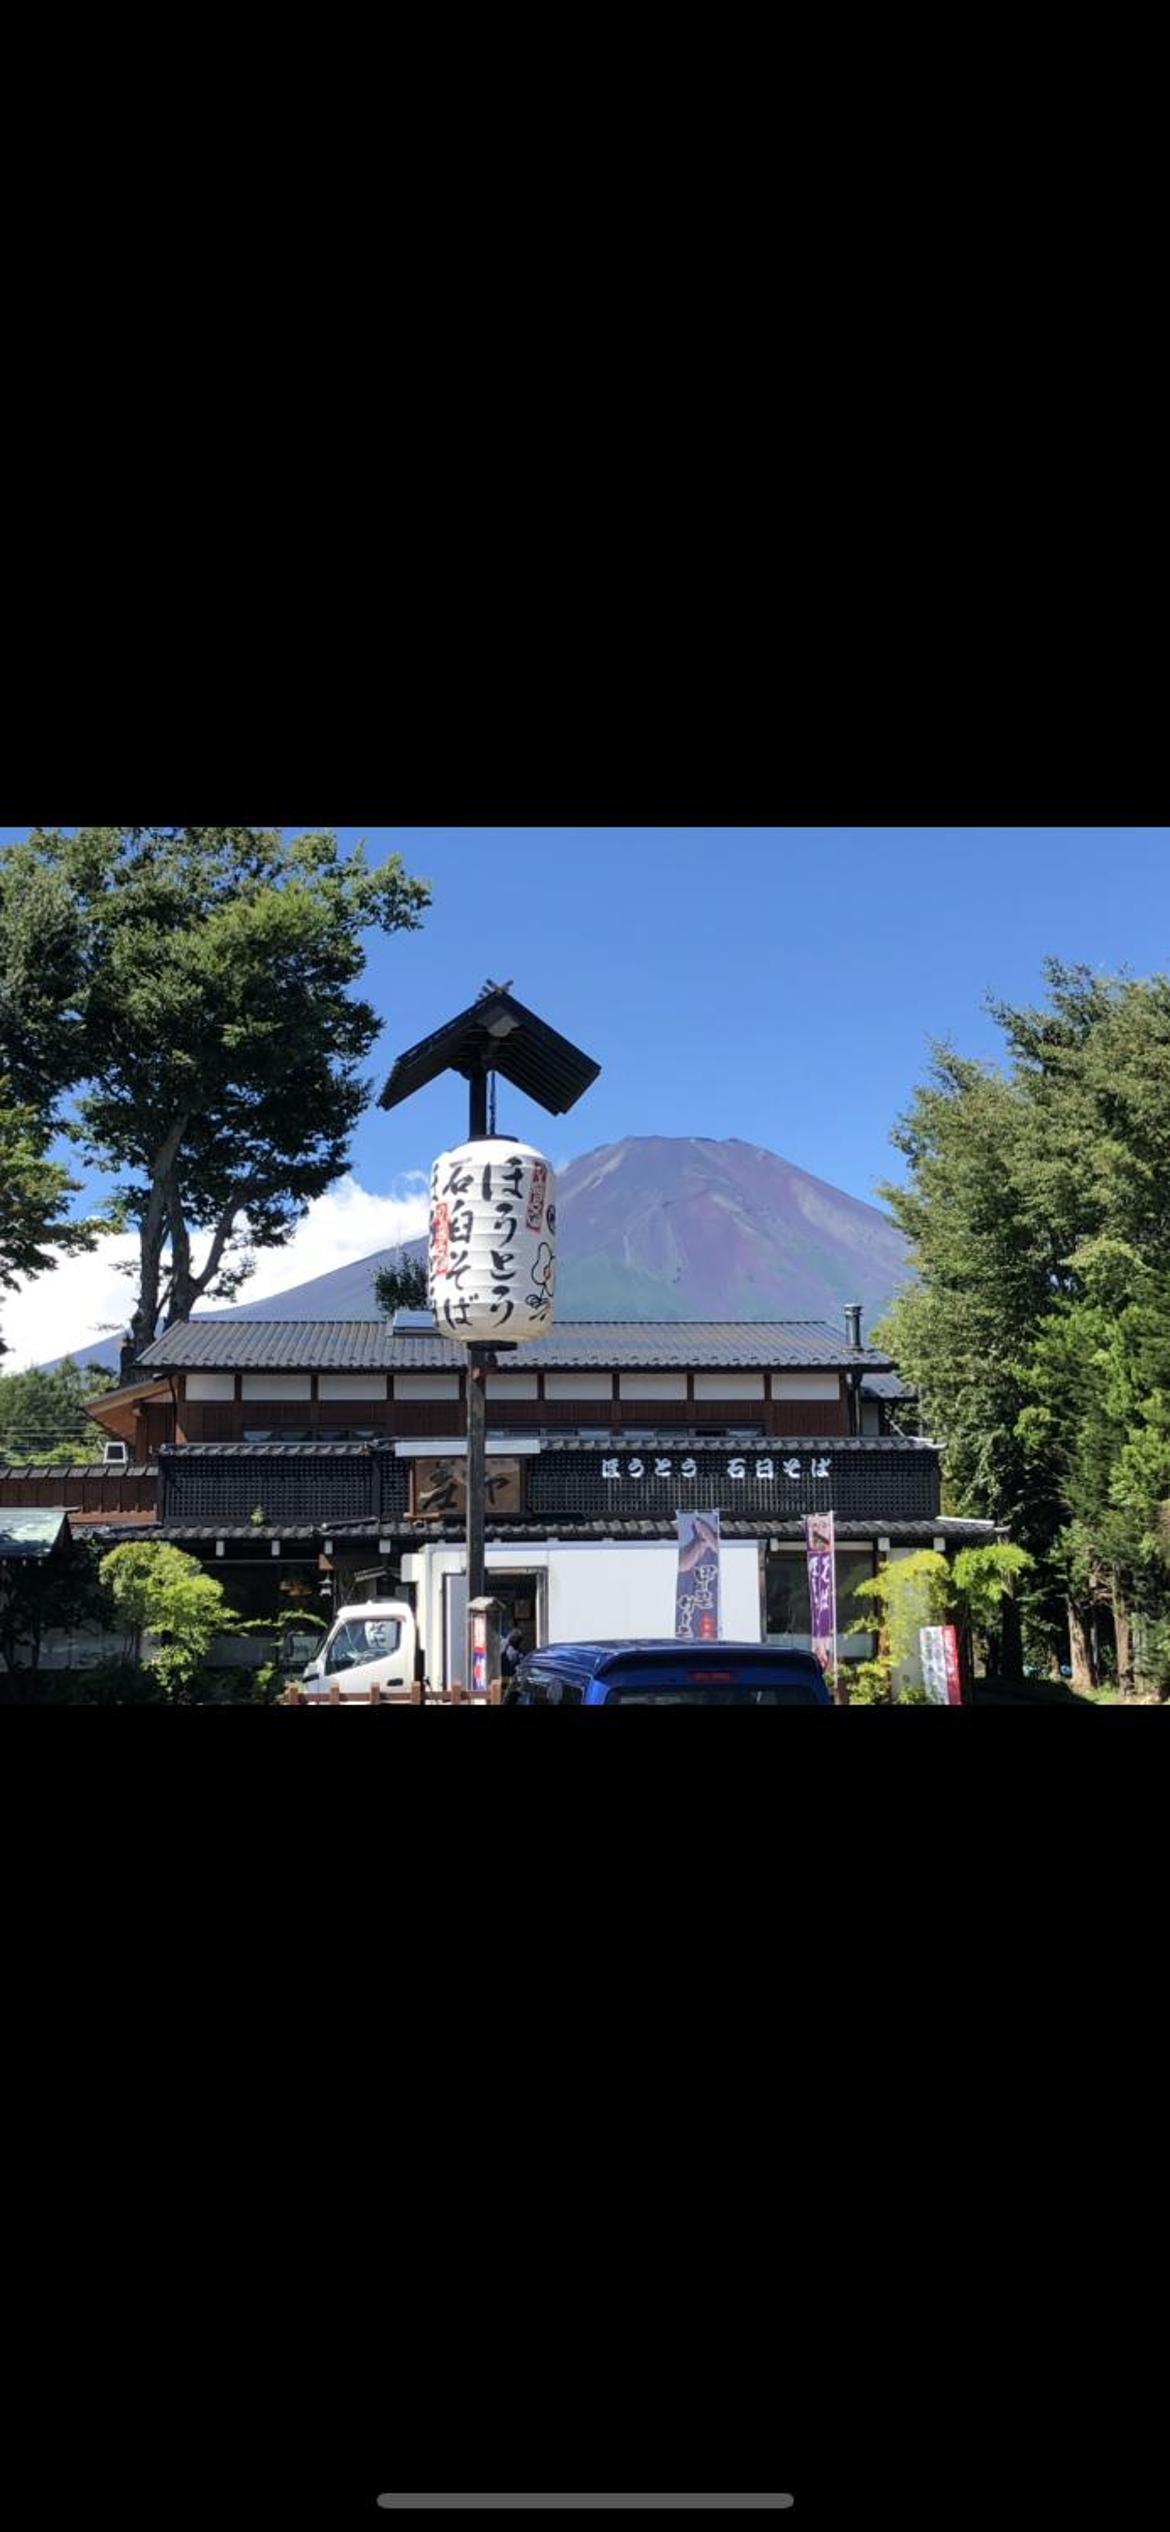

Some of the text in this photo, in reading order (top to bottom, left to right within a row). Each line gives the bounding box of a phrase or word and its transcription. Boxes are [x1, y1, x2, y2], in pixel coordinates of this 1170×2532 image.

[482, 1156, 524, 1328] ほうとう
[601, 1457, 698, 1478] ほうとう
